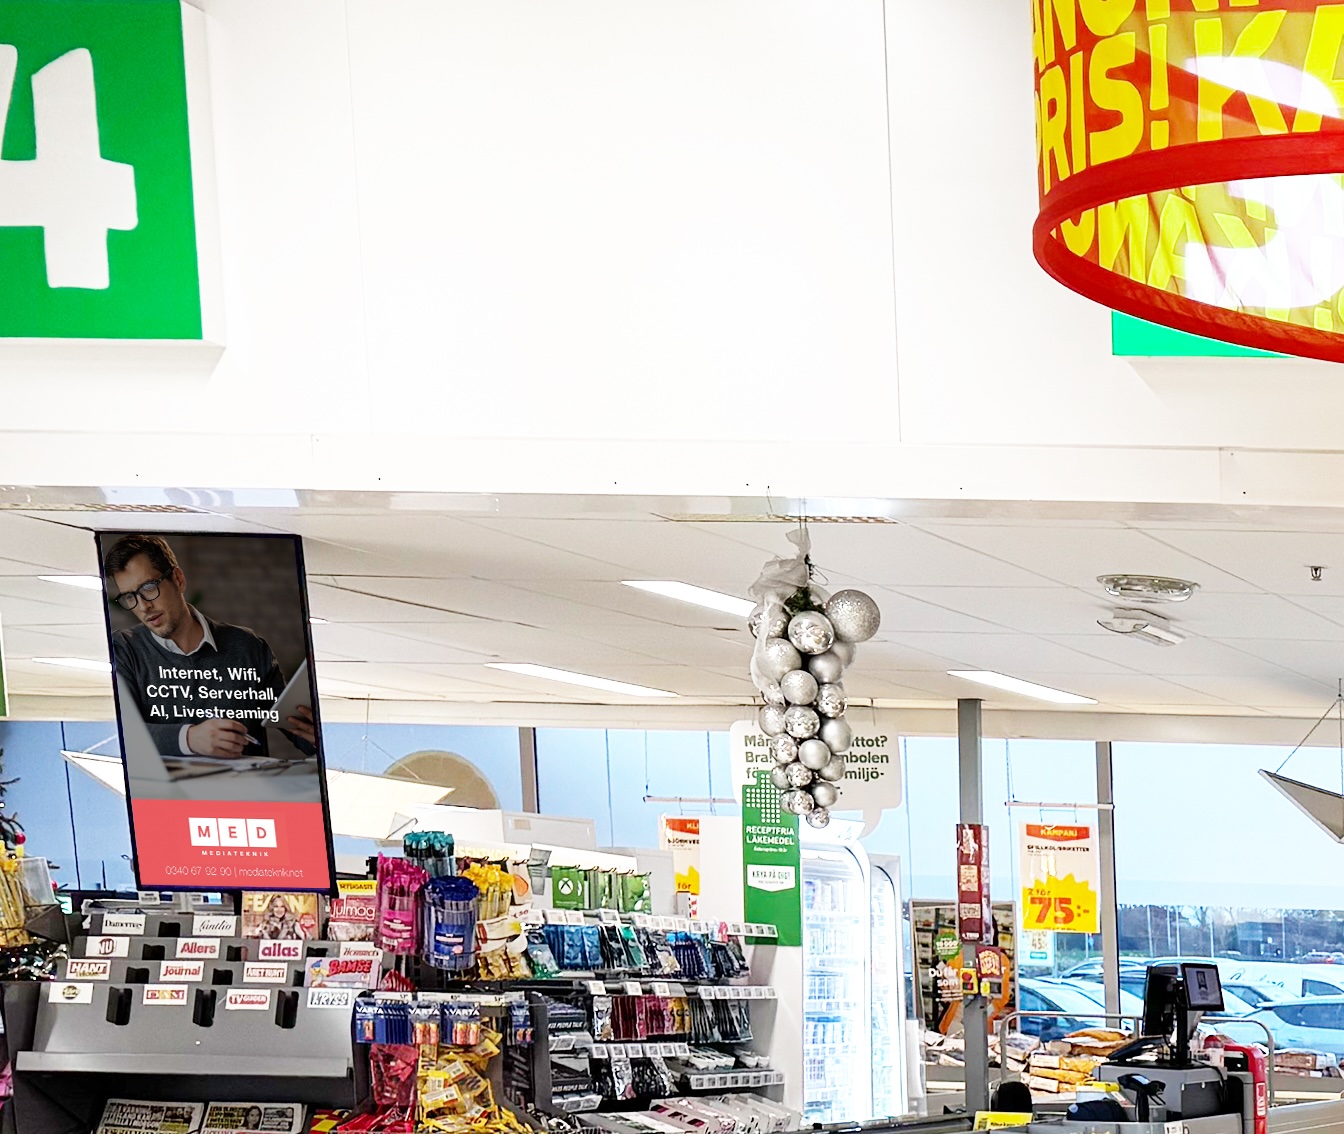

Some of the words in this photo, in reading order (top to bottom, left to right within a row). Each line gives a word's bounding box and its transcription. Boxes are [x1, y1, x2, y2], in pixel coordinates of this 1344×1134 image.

[0, 43, 139, 290] 4
[158, 666, 223, 682] Internet,
[228, 667, 261, 683] Wifi,
[147, 685, 193, 701] CCTV,
[198, 685, 278, 702] Serverhall,
[150, 705, 169, 720] AI,
[173, 705, 279, 722] Livestreaming
[745, 748, 772, 763] Bra!
[844, 767, 884, 783] miljö-
[197, 825, 267, 839] MED
[746, 826, 795, 836] RECEPTFRIA
[1040, 828, 1077, 837] KAMPANJ
[746, 835, 795, 845] LÄKEMEDEL
[180, 941, 216, 954] Allers
[261, 943, 299, 957] allas
[163, 964, 201, 977] Journal
[329, 958, 373, 977] BAMSE
[356, 1007, 383, 1015] VARTA
[409, 1008, 440, 1016] VARTA
[449, 1008, 480, 1016] VARTA
